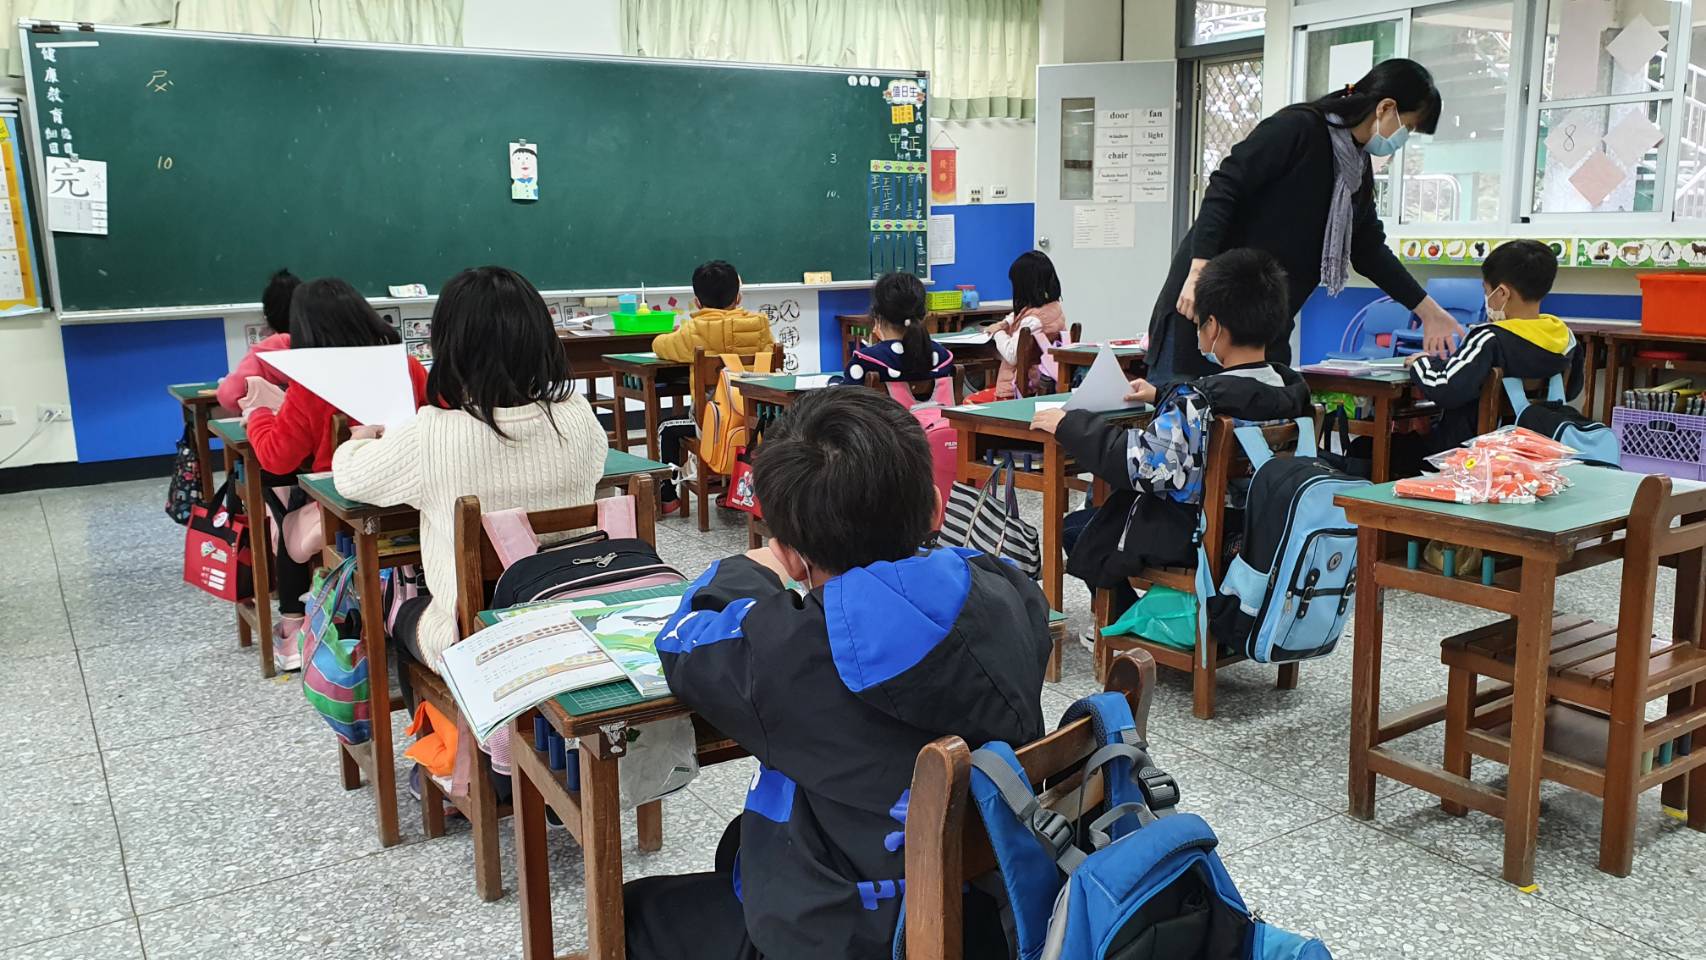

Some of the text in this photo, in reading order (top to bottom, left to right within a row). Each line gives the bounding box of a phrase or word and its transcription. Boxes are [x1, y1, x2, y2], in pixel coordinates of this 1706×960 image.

[1149, 110, 1163, 118] fan
[1147, 131, 1164, 139] light
[1563, 124, 1576, 152] 8
[1107, 152, 1129, 160] chair
[157, 155, 173, 170] 10
[51, 161, 90, 198] 完
